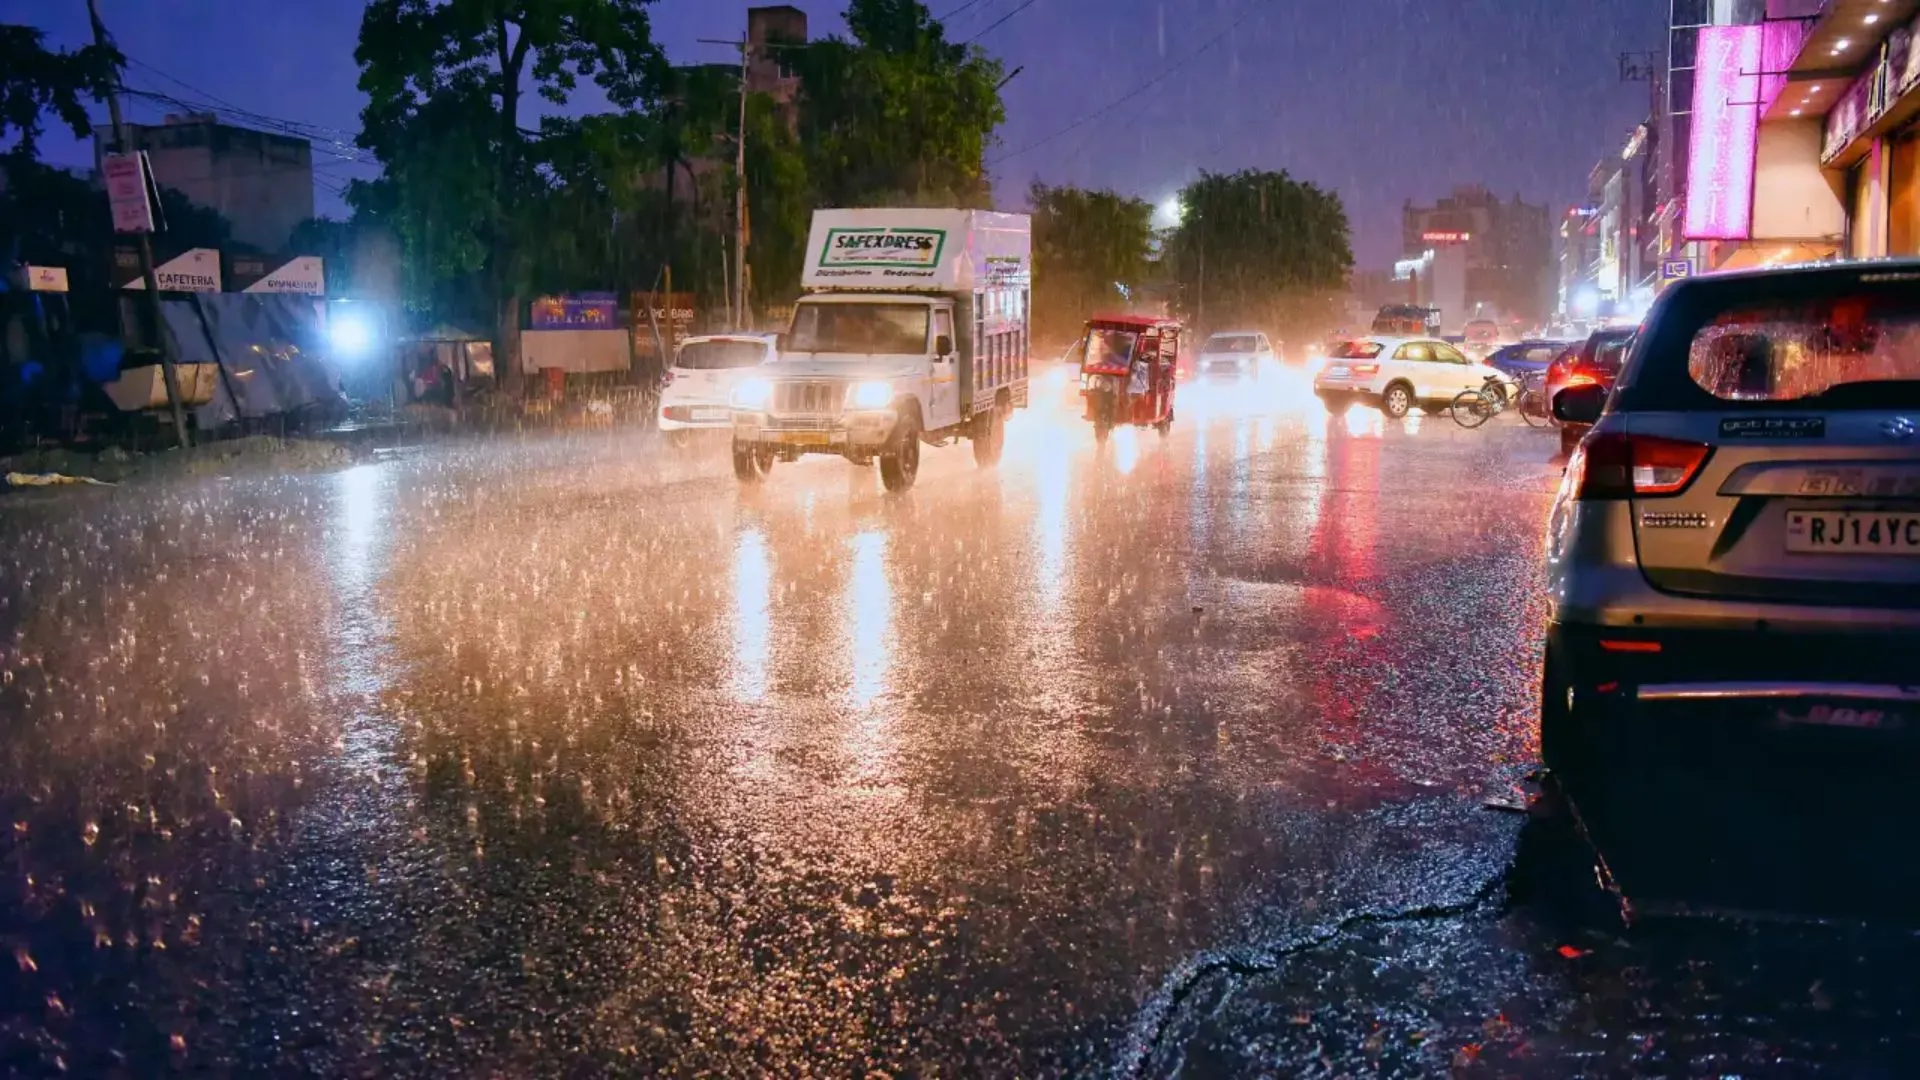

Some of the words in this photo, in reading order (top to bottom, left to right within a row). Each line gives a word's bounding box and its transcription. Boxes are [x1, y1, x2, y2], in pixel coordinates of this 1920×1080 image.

[835, 235, 933, 250] SAFEXPRESS
[158, 274, 215, 286] CAFETERIA
[267, 279, 318, 289] GYMNASIUM
[1810, 516, 1919, 546] RJ14YC
